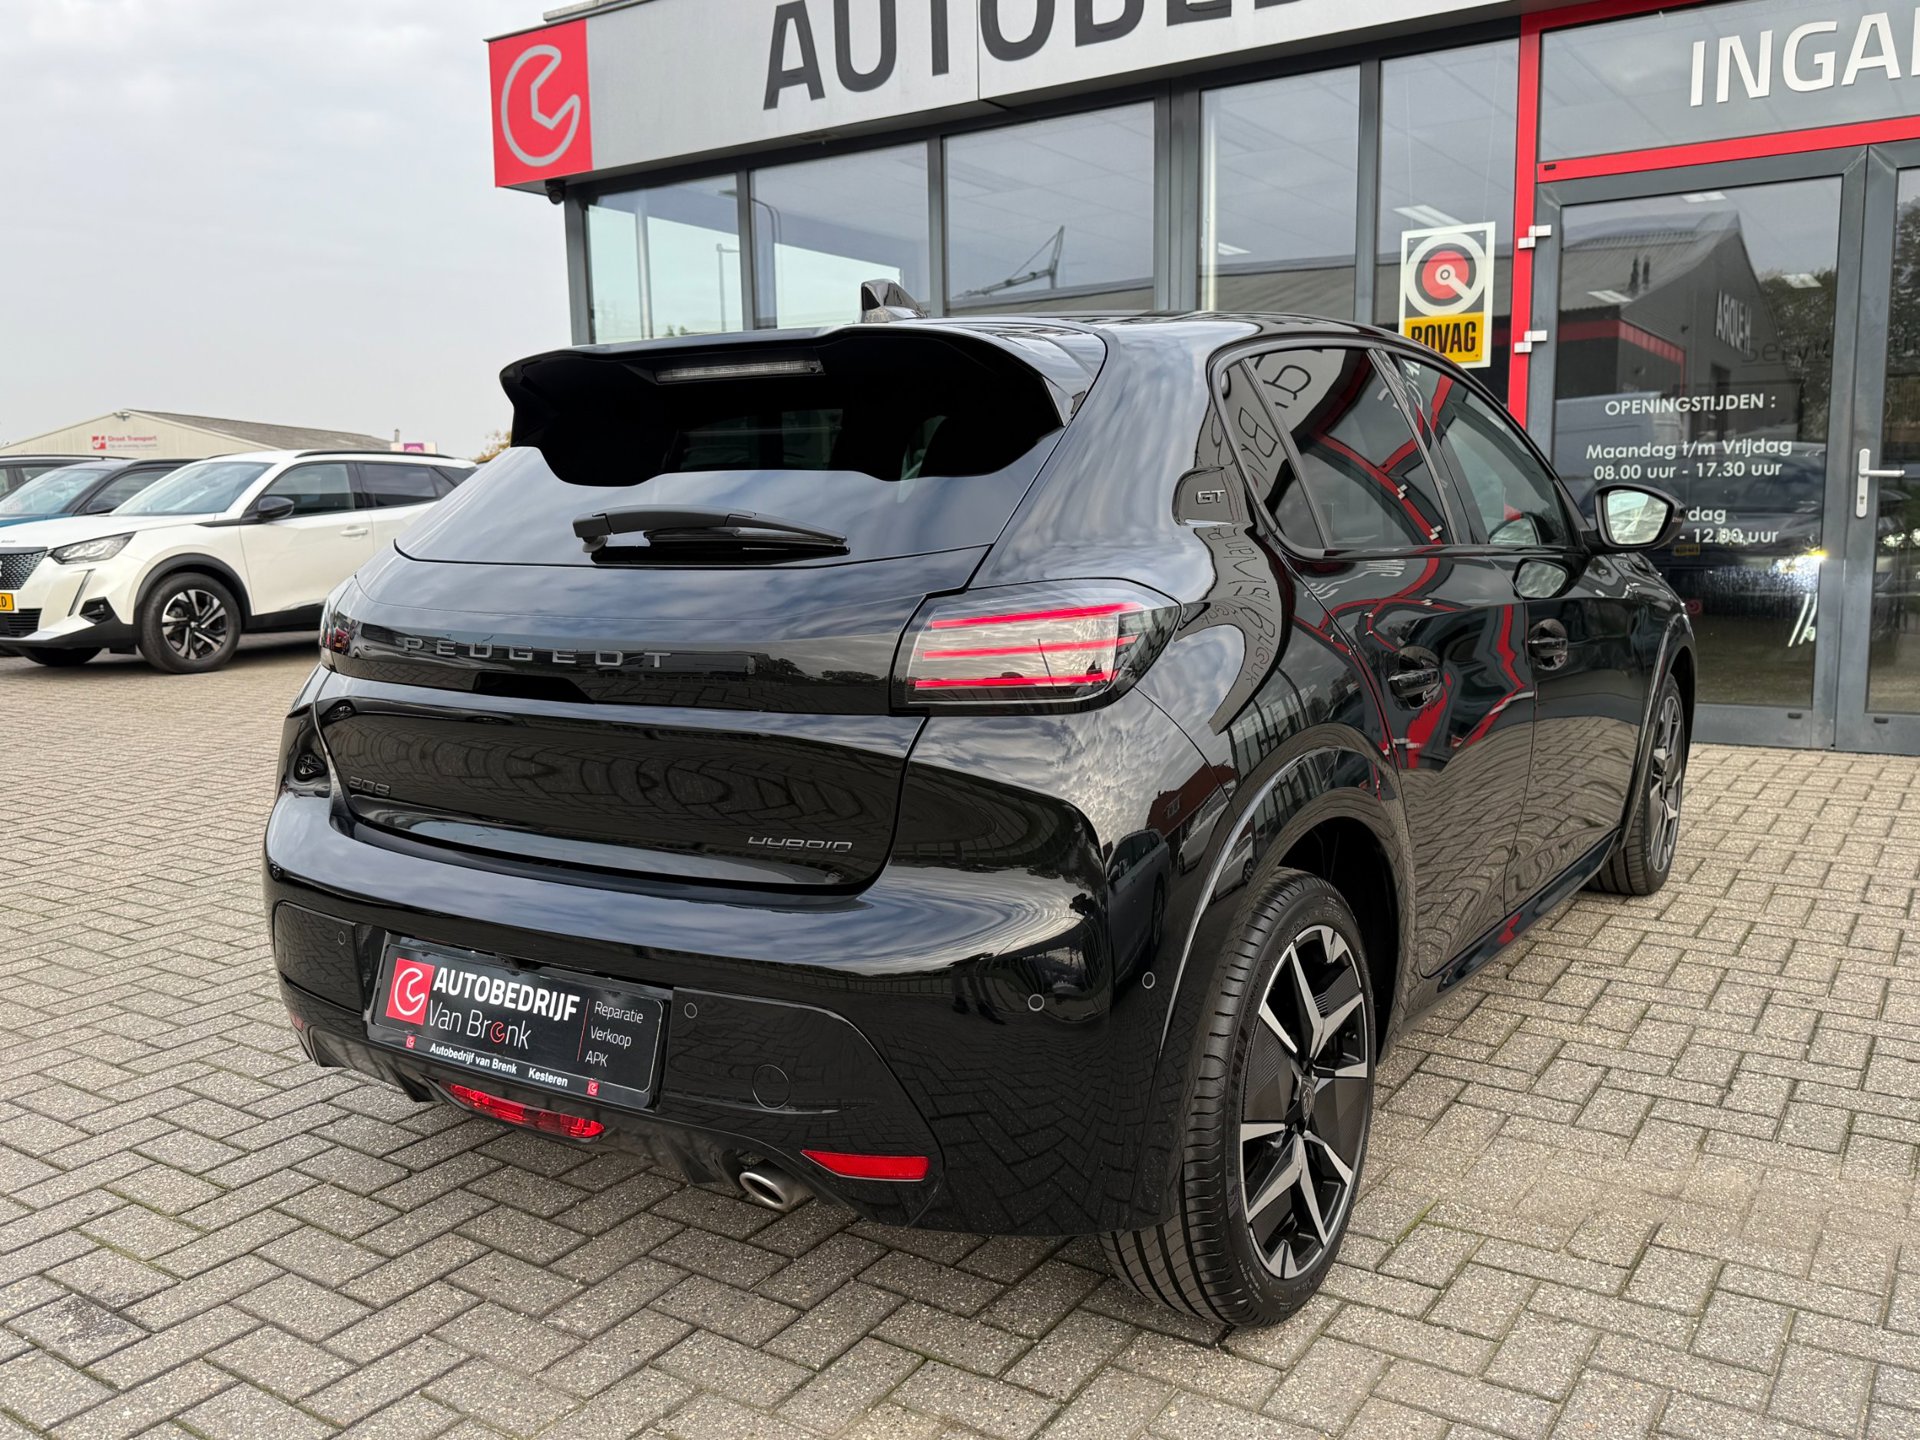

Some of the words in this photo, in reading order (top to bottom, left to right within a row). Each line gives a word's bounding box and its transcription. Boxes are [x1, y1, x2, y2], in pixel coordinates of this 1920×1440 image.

[1605, 394, 1765, 416] OPENINGSTIJDEN
[1586, 442, 1677, 460] Maandag
[1682, 441, 1716, 458] t/m
[1722, 438, 1793, 458] Vrijdag
[1593, 464, 1642, 480] 08.00
[1646, 465, 1676, 479] uur
[1696, 461, 1746, 478] 17.30
[1751, 463, 1783, 476] uur
[1196, 489, 1225, 504] GT
[1693, 528, 1742, 543] 12.00
[1748, 531, 1779, 543] uur
[403, 637, 672, 668] PEUGEOT
[349, 776, 391, 796] 208
[432, 967, 581, 1022] AUTOBEDRIJF
[594, 1001, 644, 1024] Reparatie
[428, 999, 462, 1033] Van
[466, 1009, 532, 1050] Brenk
[590, 1025, 632, 1050] Verkoop
[429, 1043, 475, 1065] Autobedrijf
[475, 1055, 490, 1066] van
[491, 1058, 518, 1075] Brenk
[528, 1067, 569, 1088] Kesteren
[585, 1050, 609, 1067] APK
